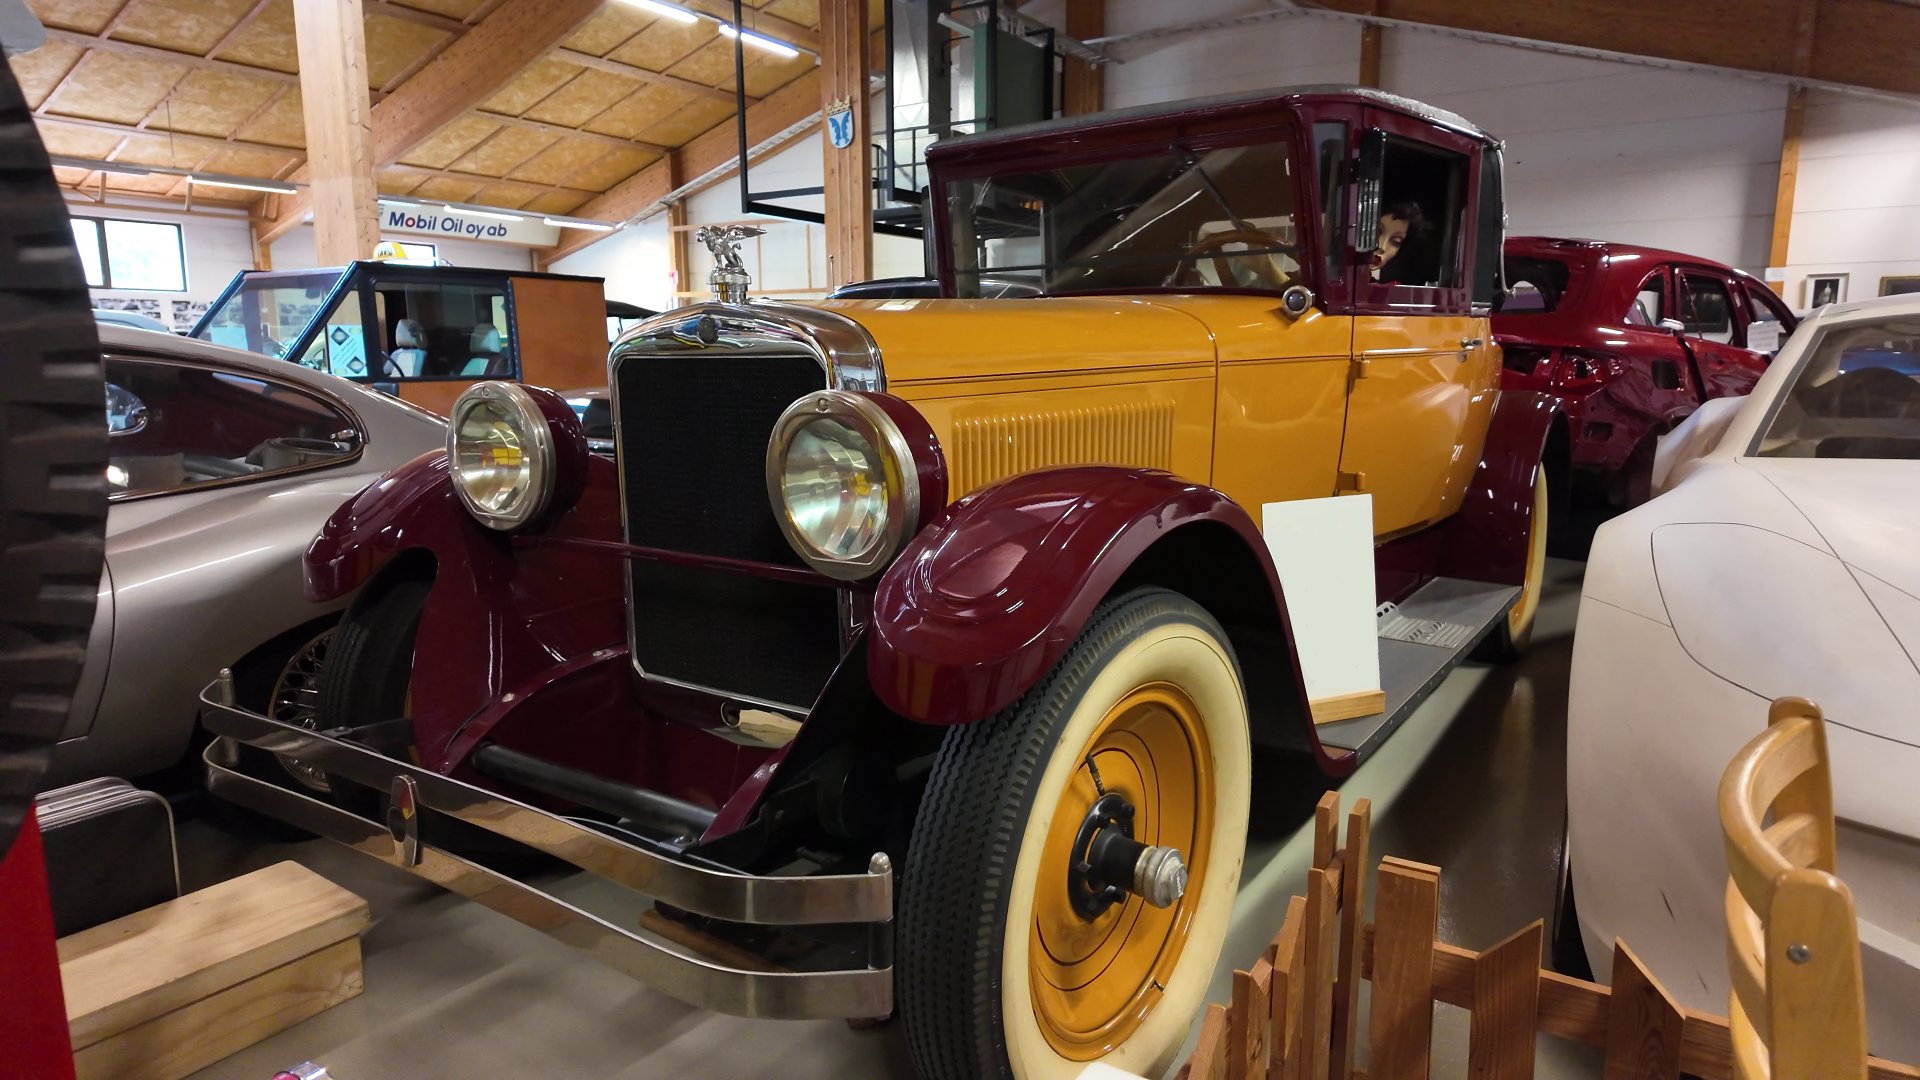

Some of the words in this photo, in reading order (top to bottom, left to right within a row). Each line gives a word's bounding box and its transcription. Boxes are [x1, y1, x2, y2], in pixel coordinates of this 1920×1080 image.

[389, 211, 437, 230] Mobil
[441, 217, 463, 233] Oil
[466, 224, 485, 239] oy
[487, 223, 507, 236] ab
